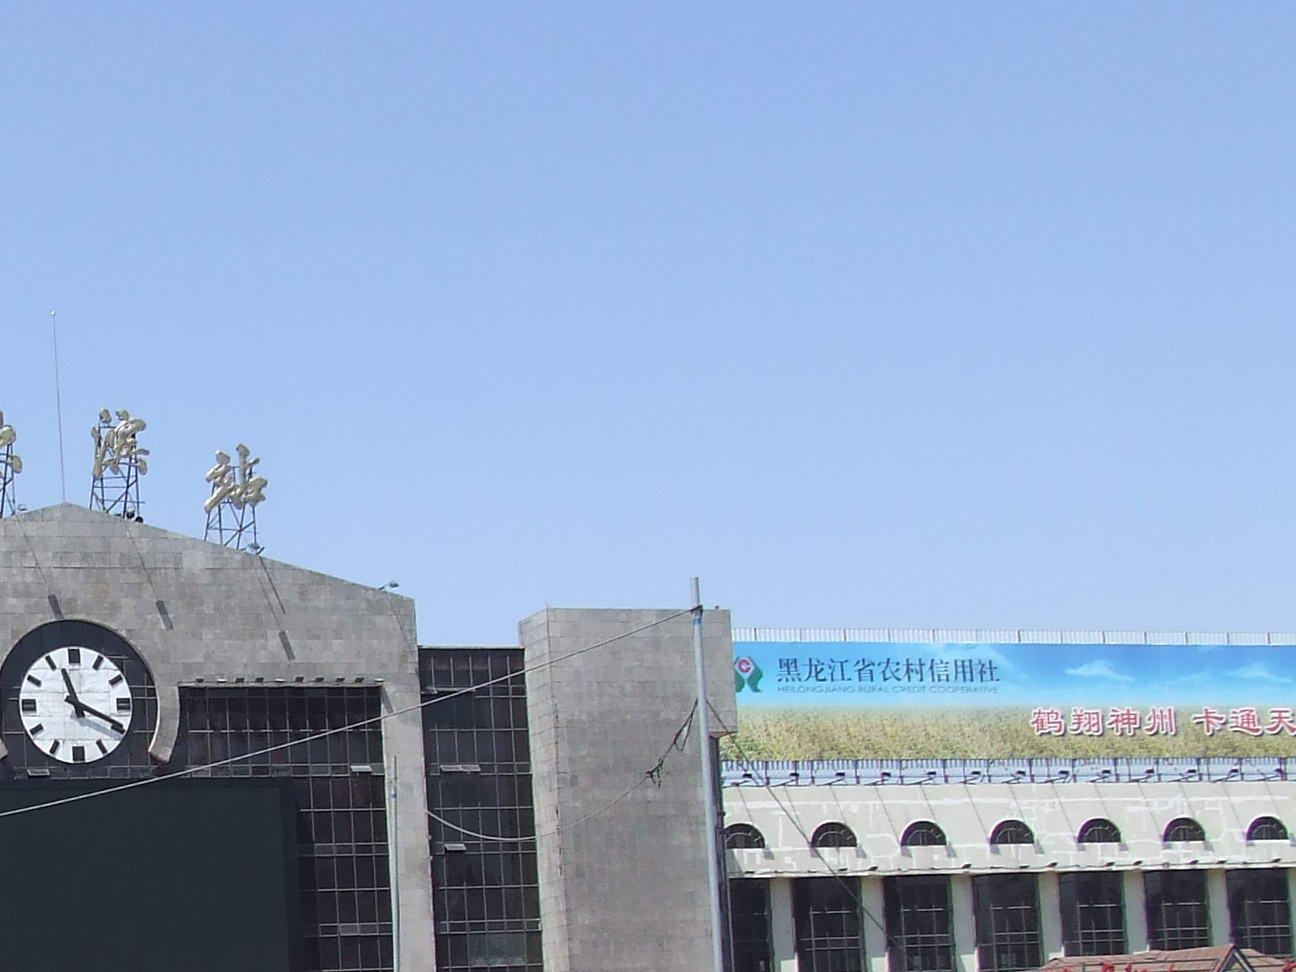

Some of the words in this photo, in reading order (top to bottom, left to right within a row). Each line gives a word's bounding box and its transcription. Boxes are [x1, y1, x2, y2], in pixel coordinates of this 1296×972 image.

[777, 657, 1001, 683] 黑龙江省农村信用社
[1031, 706, 1177, 736] 鹤翔神州
